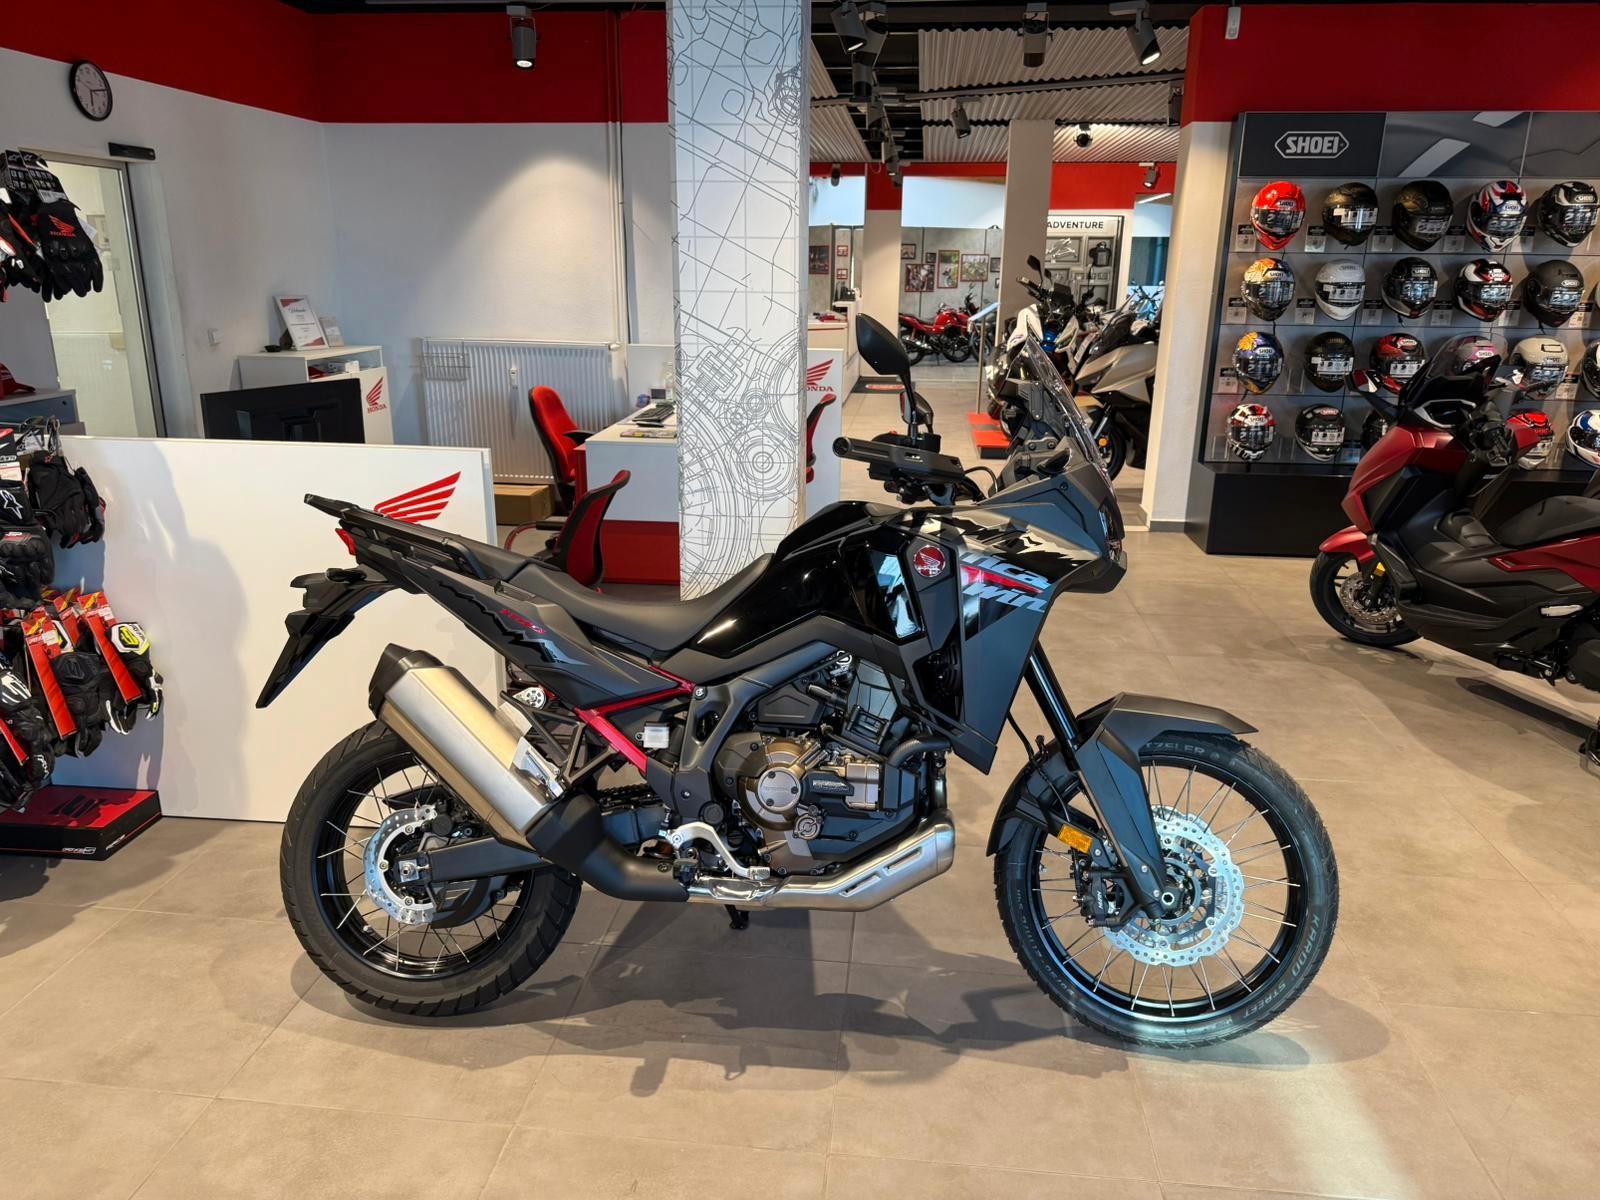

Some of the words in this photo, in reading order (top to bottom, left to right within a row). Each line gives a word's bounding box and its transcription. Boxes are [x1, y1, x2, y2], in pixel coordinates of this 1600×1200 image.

[1285, 135, 1340, 154] SHOEI
[1046, 221, 1104, 229] ADVENTURE
[1145, 742, 1205, 755] TZELER
[1291, 914, 1321, 977] KAROO
[1243, 982, 1287, 1018] STREET
